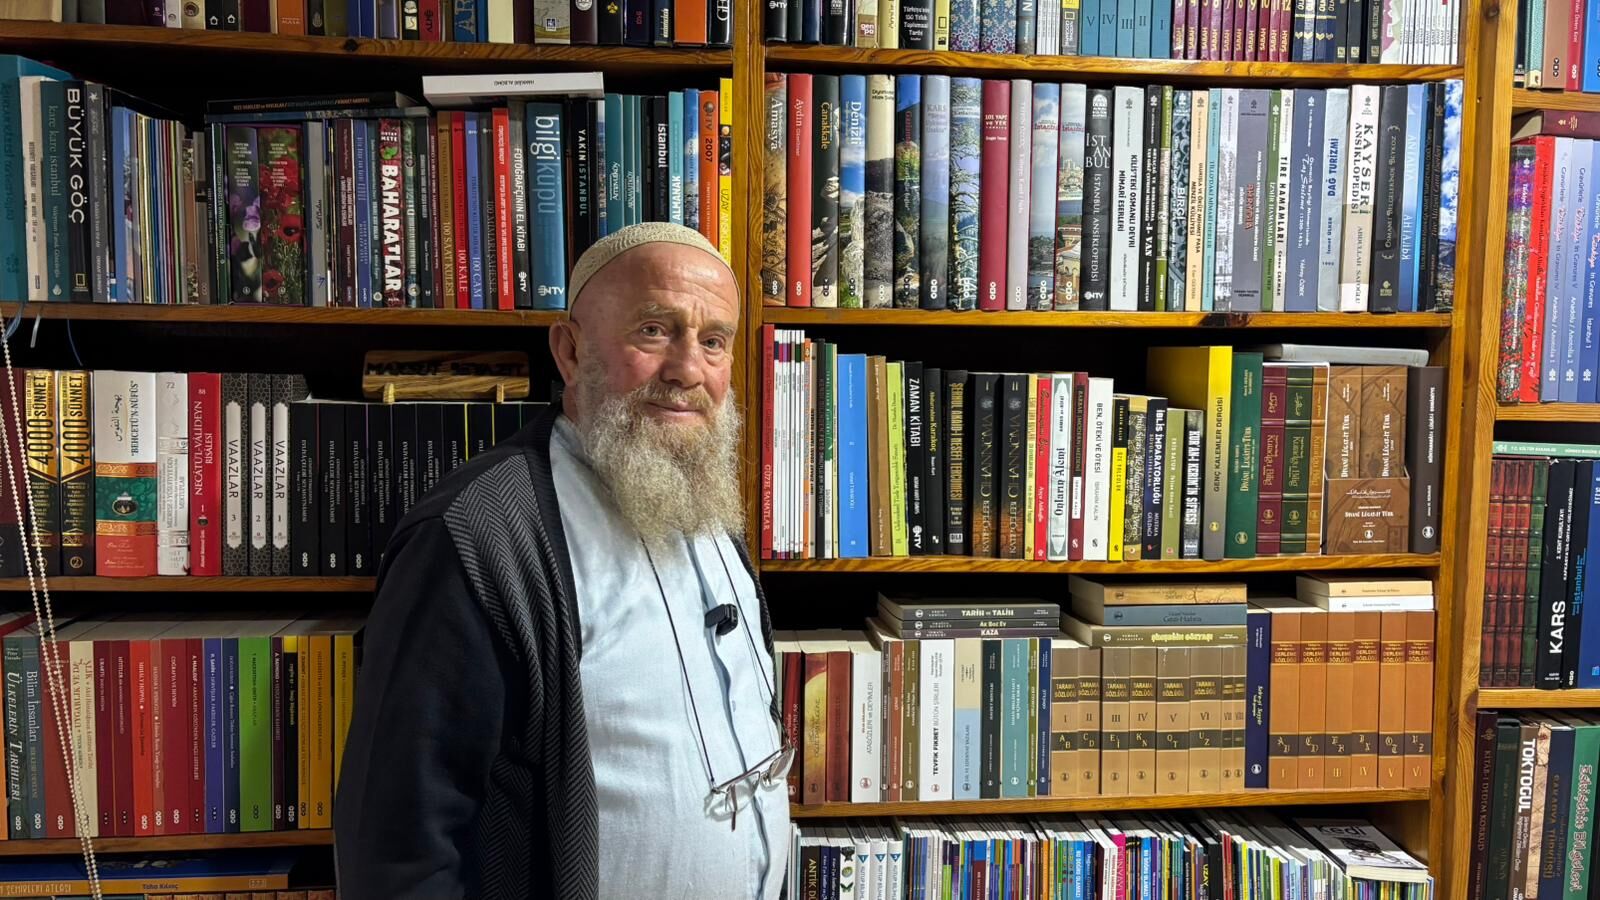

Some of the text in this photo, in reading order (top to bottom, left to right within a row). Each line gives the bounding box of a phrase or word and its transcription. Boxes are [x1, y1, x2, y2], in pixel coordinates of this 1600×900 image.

[1102, 14, 1114, 25] IV
[1121, 18, 1133, 30] III
[1139, 15, 1147, 27] II
[1210, 28, 1218, 52] SABAH
[1280, 30, 1288, 53] SABAH
[48, 105, 60, 152] kare kare
[768, 97, 783, 151] Amasya
[794, 98, 804, 127] Aydın
[819, 101, 831, 149] Çanakkale
[850, 100, 863, 145] Denizli
[67, 88, 88, 224] BÜYÜK GÖÇ
[578, 129, 587, 161] YAKIN
[657, 123, 668, 168] istanbul
[705, 137, 713, 163] 2007
[1085, 156, 1111, 168] BUL
[1326, 138, 1339, 196] DAĞ TURİZMİ
[1350, 122, 1363, 215] ANSİKLOPEDİSİ
[1359, 123, 1374, 215] KAYSERİ
[512, 147, 526, 252] FOTOĞRAFÇININ EL KİTABI
[672, 175, 681, 221] ALMANAK
[720, 188, 730, 212] UZAY
[1117, 200, 1126, 232] ESERLERİ
[1128, 154, 1138, 248] KİLİS'TEKİ OSMANLI DEVRİ
[1176, 187, 1186, 220] BİRGİ
[1196, 195, 1204, 213] ÖKÜZ
[1276, 156, 1289, 244] TİRE HAMAMLARI
[382, 164, 402, 292] BAHARATLAR
[443, 222, 452, 235] 100
[1091, 173, 1102, 282] İSTANBUL ANSİKLOPEDİSİ
[1189, 205, 1197, 236] KÜLLİYESİ
[1266, 203, 1275, 247] HAMAMLARI
[443, 236, 453, 263] SAAT
[1145, 236, 1153, 257] VAN
[458, 248, 468, 293] 100 KALE
[472, 257, 483, 298] 100 CAM
[1550, 295, 1560, 325] Anadolu
[1568, 295, 1578, 325] Anadolu
[1588, 279, 1596, 309] Gravures
[33, 375, 47, 417] SÜNNET
[69, 375, 83, 417] SÜNNET
[908, 377, 922, 446] ZAMAN KİTABI
[1095, 402, 1104, 419] BEN,
[27, 418, 54, 466] 4000
[62, 418, 90, 466] 4000
[928, 422, 938, 451] Karakoç
[1095, 420, 1104, 441] ÖTEKİ
[1095, 442, 1102, 452] VE
[1187, 430, 1200, 463] KUR'AN-I
[1212, 396, 1223, 492] GENÇ KALEMLER DERGİSİ
[227, 439, 240, 500] VAAZLAR
[252, 439, 265, 500] VAAZLAR
[274, 439, 287, 500] VAAZLAR
[1094, 453, 1103, 473] ÖTESİ
[1152, 409, 1165, 504] İBLİS İMPARATORLUĞU
[1262, 434, 1274, 486] Kutadgu Bilig
[1289, 436, 1301, 487] Kutadgu Bilig
[1054, 479, 1066, 516] Onların
[1186, 463, 1199, 496] KERİM'İN
[763, 490, 771, 530] SANATLAR
[1556, 540, 1564, 553] KENT
[961, 609, 1014, 617] TARİH TALİH
[1549, 600, 1567, 654] KARS
[26, 671, 39, 743] Bilim İnsanları
[1085, 713, 1093, 721] II
[1111, 715, 1121, 723] III
[1137, 712, 1148, 721] IV
[1200, 712, 1210, 720] VI
[5, 671, 24, 801] ÜLKELERİN TARİHLERİ
[865, 719, 873, 755] ATASÖZLERİ
[931, 751, 939, 776] TEVFİK
[1517, 738, 1537, 814] TOKTOGUL
[1568, 764, 1592, 892] Eskişehir Bilgeleri
[808, 858, 817, 885] ANTİK
